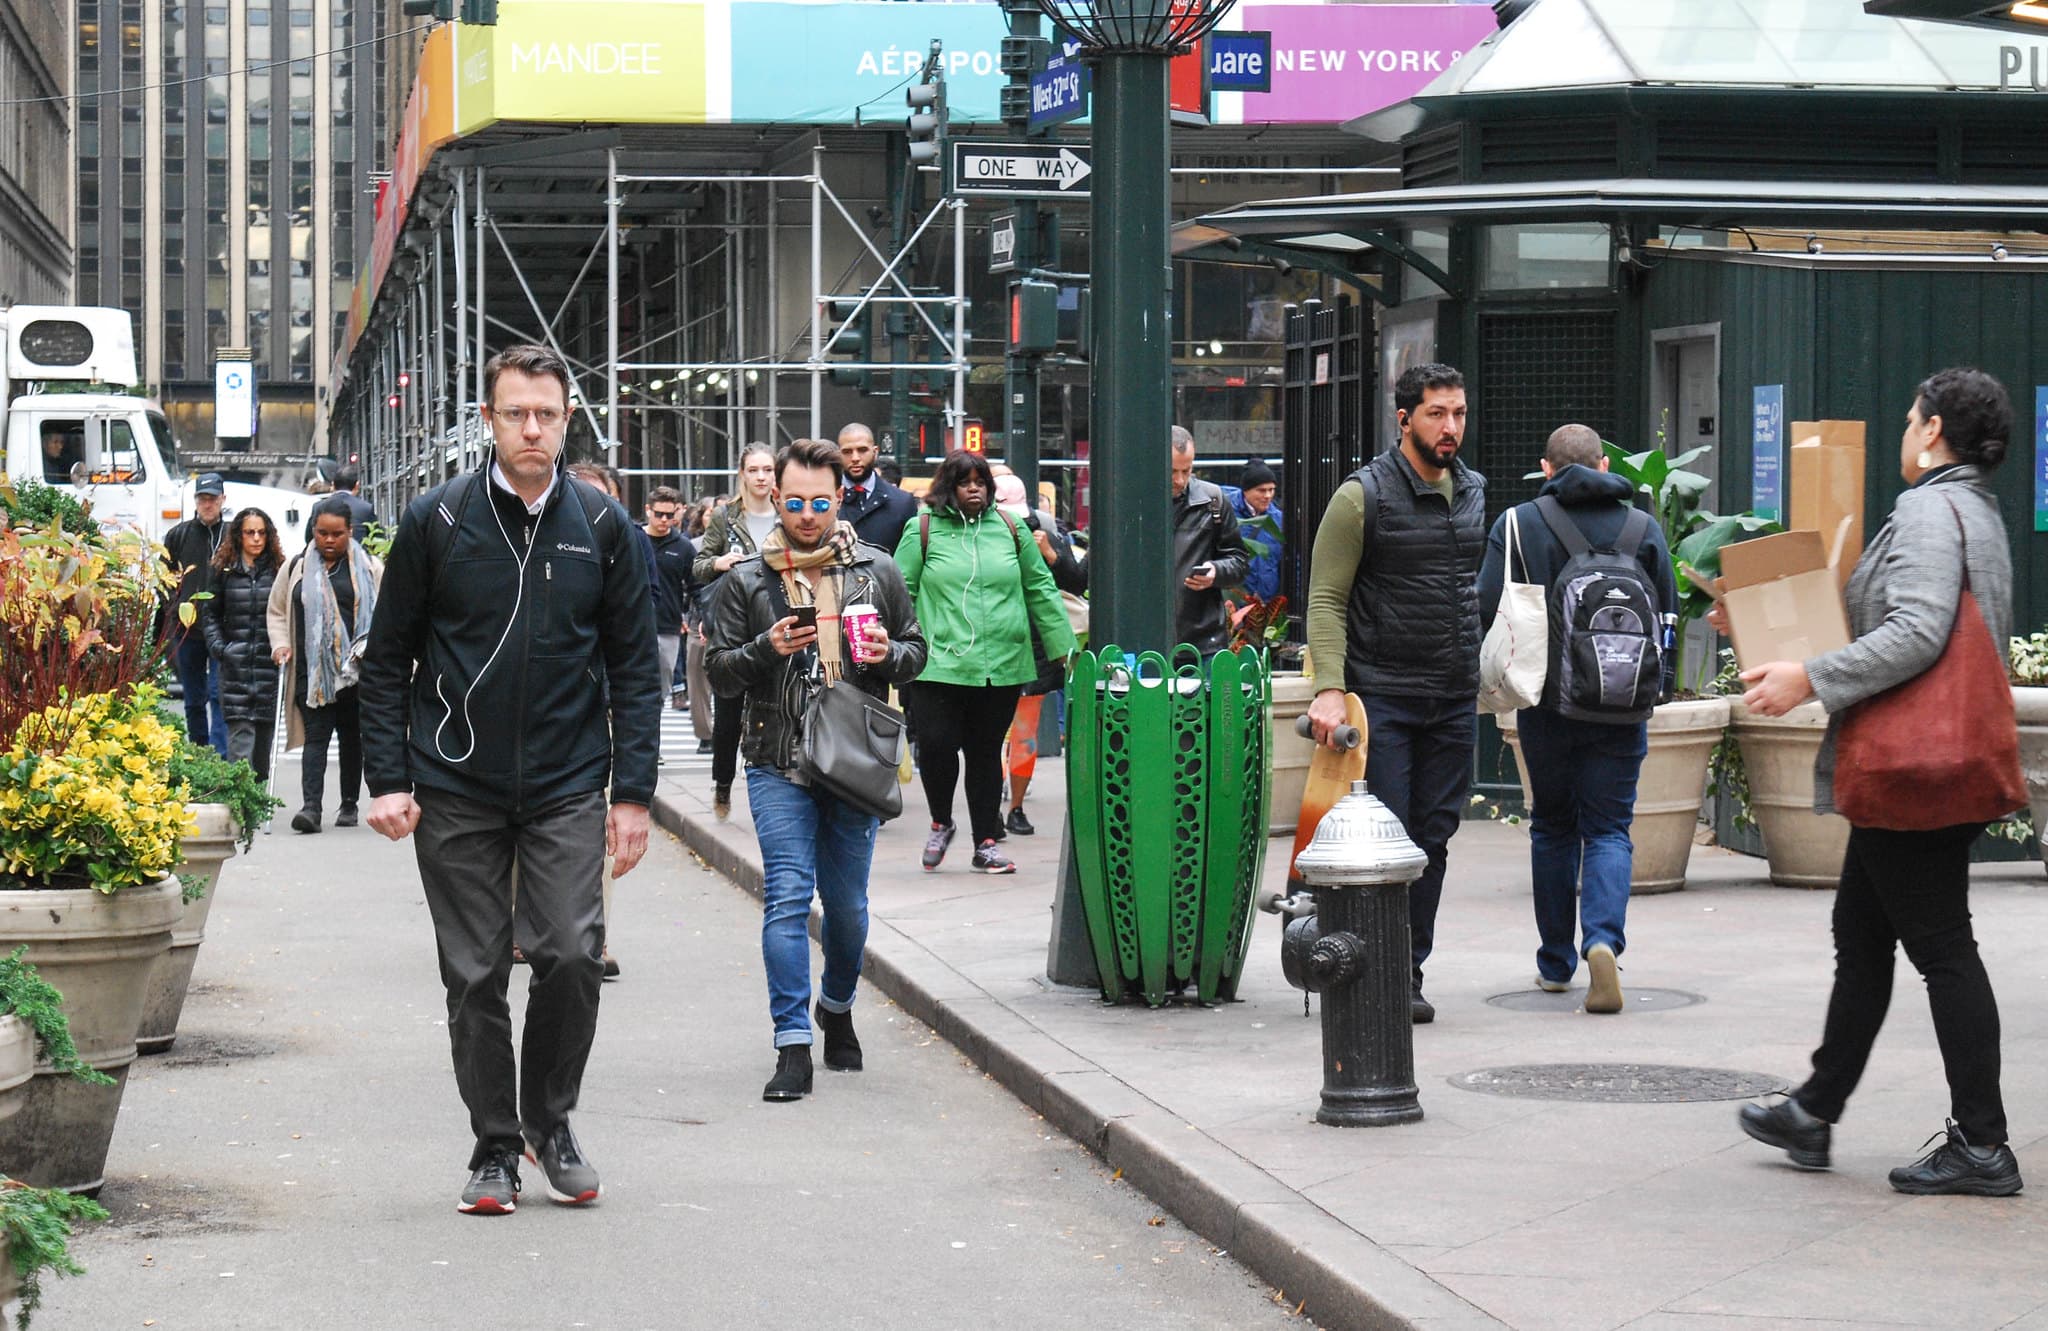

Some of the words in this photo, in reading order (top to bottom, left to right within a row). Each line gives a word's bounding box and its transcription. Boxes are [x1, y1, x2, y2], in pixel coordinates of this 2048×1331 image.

[511, 42, 663, 75] MANDEE
[855, 44, 1002, 76] AÉRPO
[1275, 49, 1346, 72] NEW
[1358, 49, 1443, 72] YORK
[1033, 82, 1052, 113] West
[1053, 72, 1069, 107] 32nd
[1070, 72, 1080, 102] St
[978, 158, 1016, 177] ONE
[1036, 159, 1078, 178] WAY
[966, 426, 981, 452] 8
[192, 455, 225, 464] PENN
[230, 455, 279, 465] STATION
[563, 543, 591, 553] Columbia
